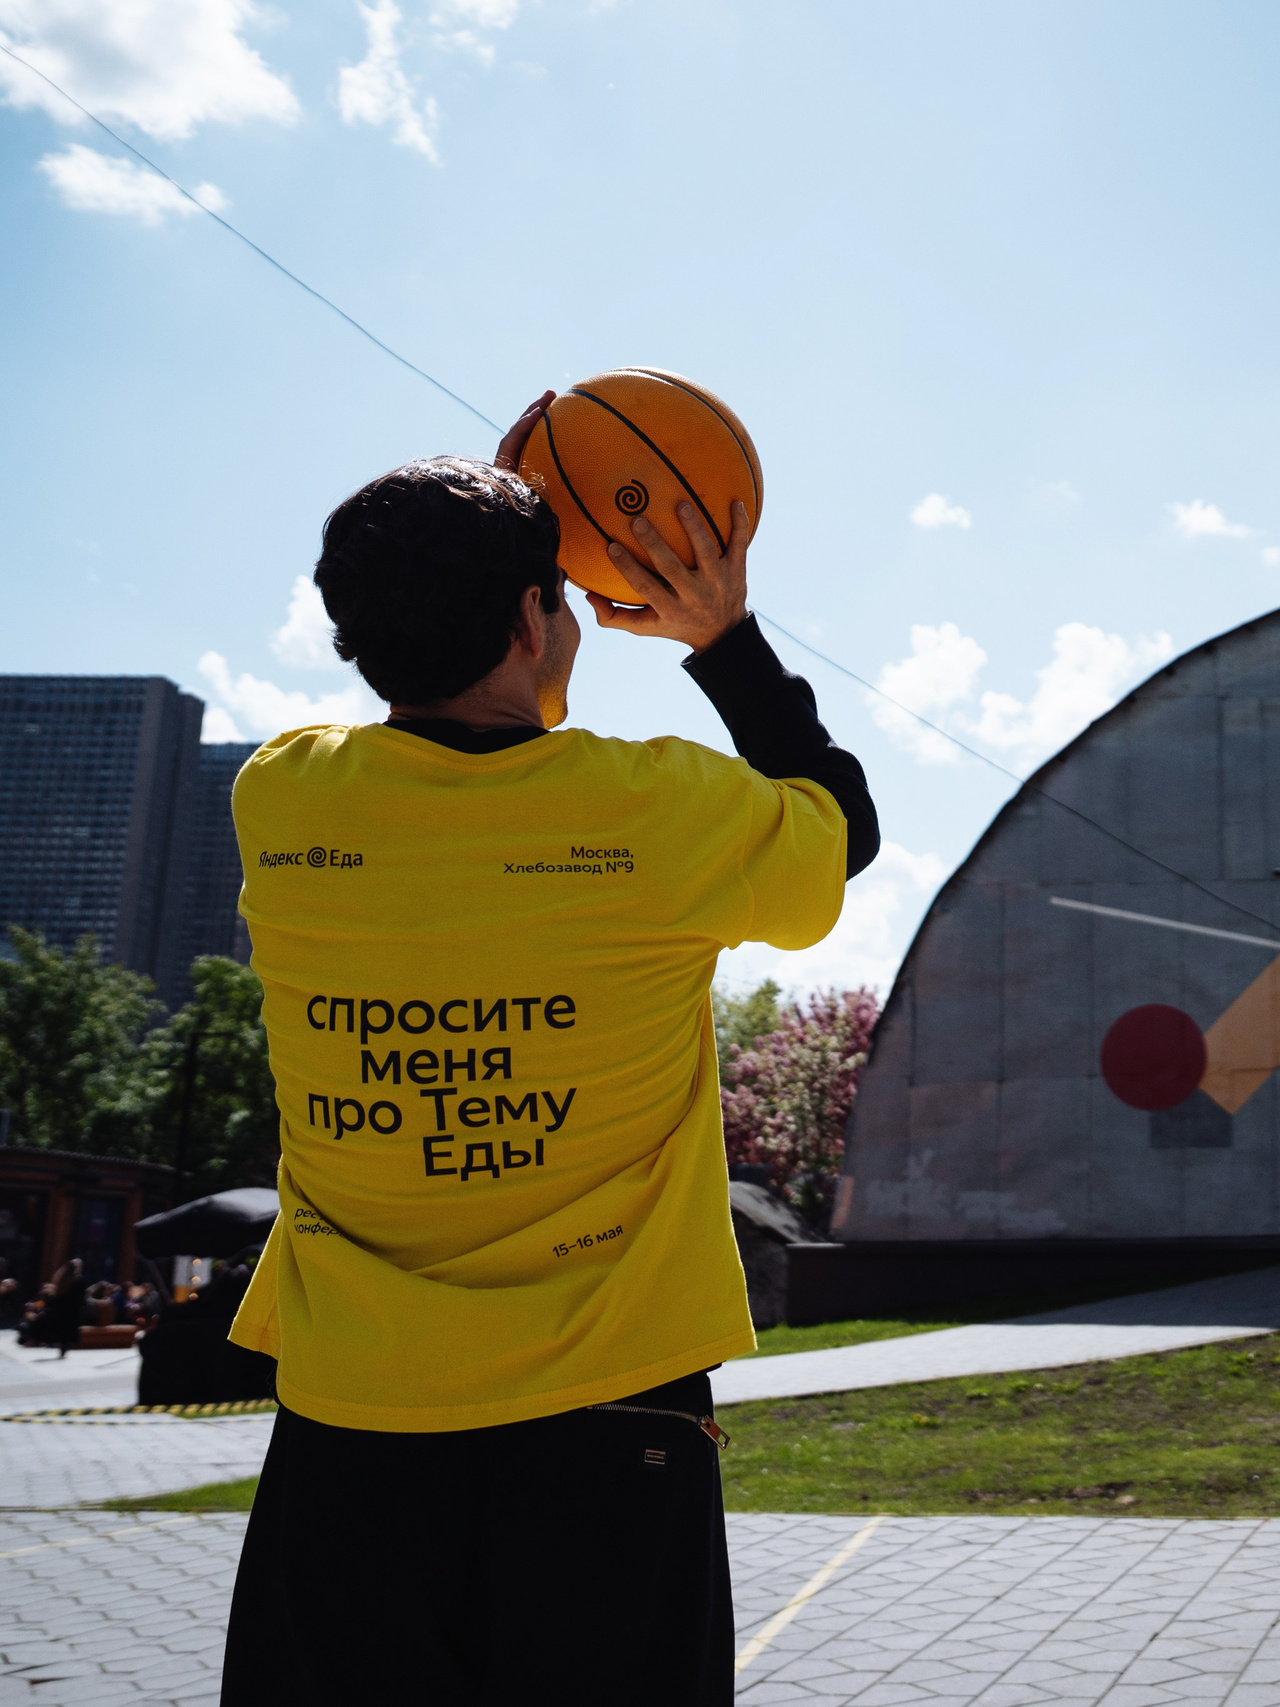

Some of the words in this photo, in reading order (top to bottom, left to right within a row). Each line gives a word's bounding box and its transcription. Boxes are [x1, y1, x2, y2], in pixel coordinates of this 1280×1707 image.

[258, 851, 304, 868] Яндекс
[329, 849, 364, 869] Еда
[570, 846, 634, 859] Москва,
[503, 862, 603, 875] Хлебозавод
[307, 995, 575, 1044] спросите
[360, 1046, 512, 1085] меня
[309, 1093, 402, 1140] про
[420, 1088, 576, 1132] Тему
[423, 1135, 543, 1181] Еды
[294, 1207, 324, 1221] рес
[595, 1224, 624, 1243] мая
